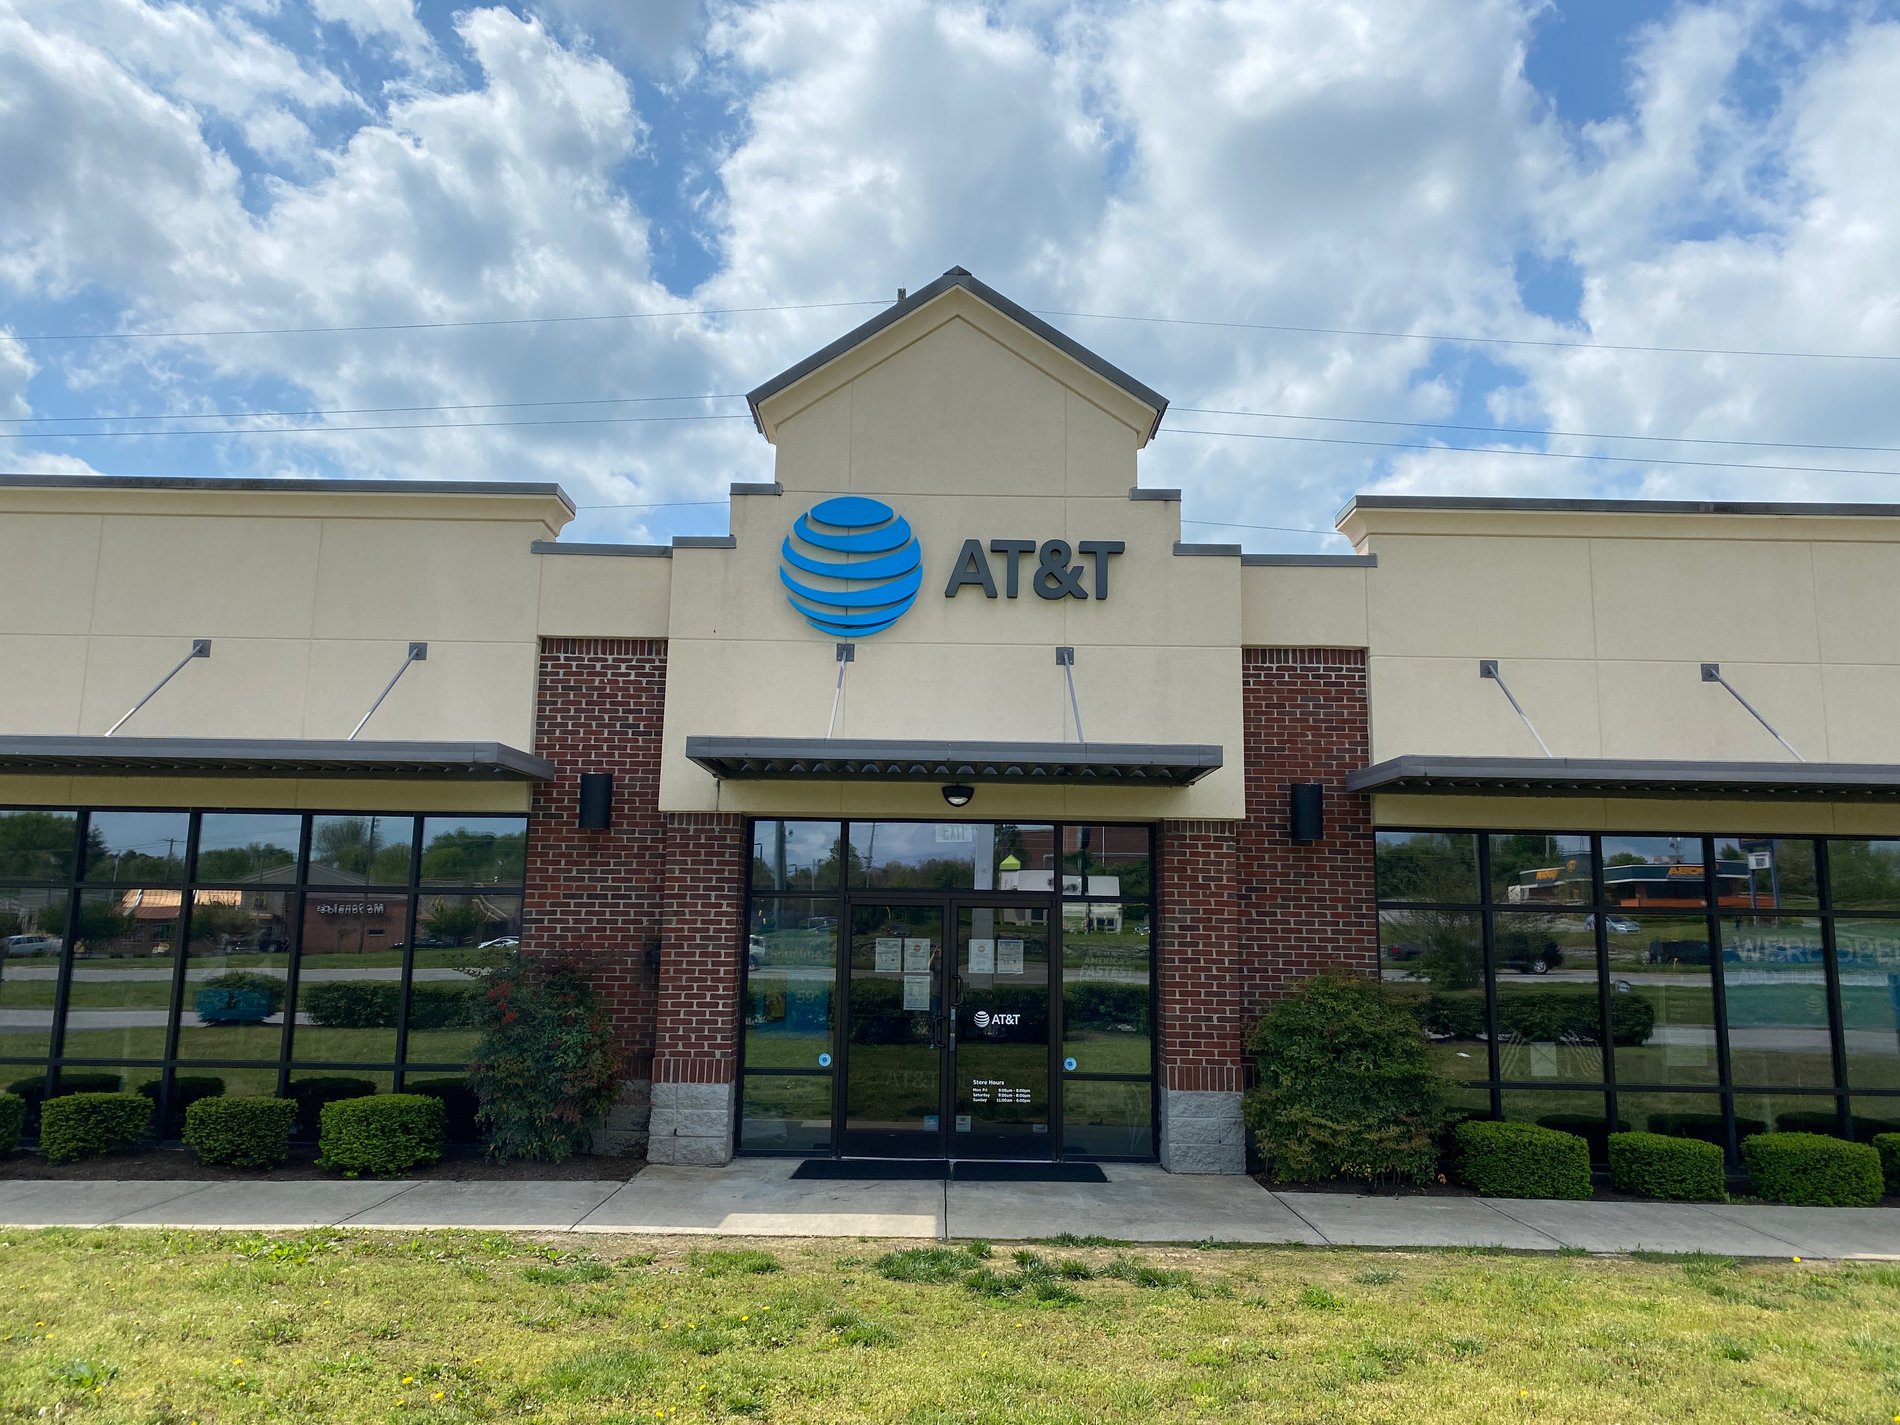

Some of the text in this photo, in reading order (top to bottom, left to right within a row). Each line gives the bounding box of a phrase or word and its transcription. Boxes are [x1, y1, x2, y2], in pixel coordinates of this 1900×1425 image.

[944, 538, 1126, 601] AT&T
[942, 825, 968, 841] EXIT
[1083, 957, 1132, 966] AMERICA'S
[1080, 965, 1136, 978] FASTEST
[991, 1014, 1021, 1025] AT&T
